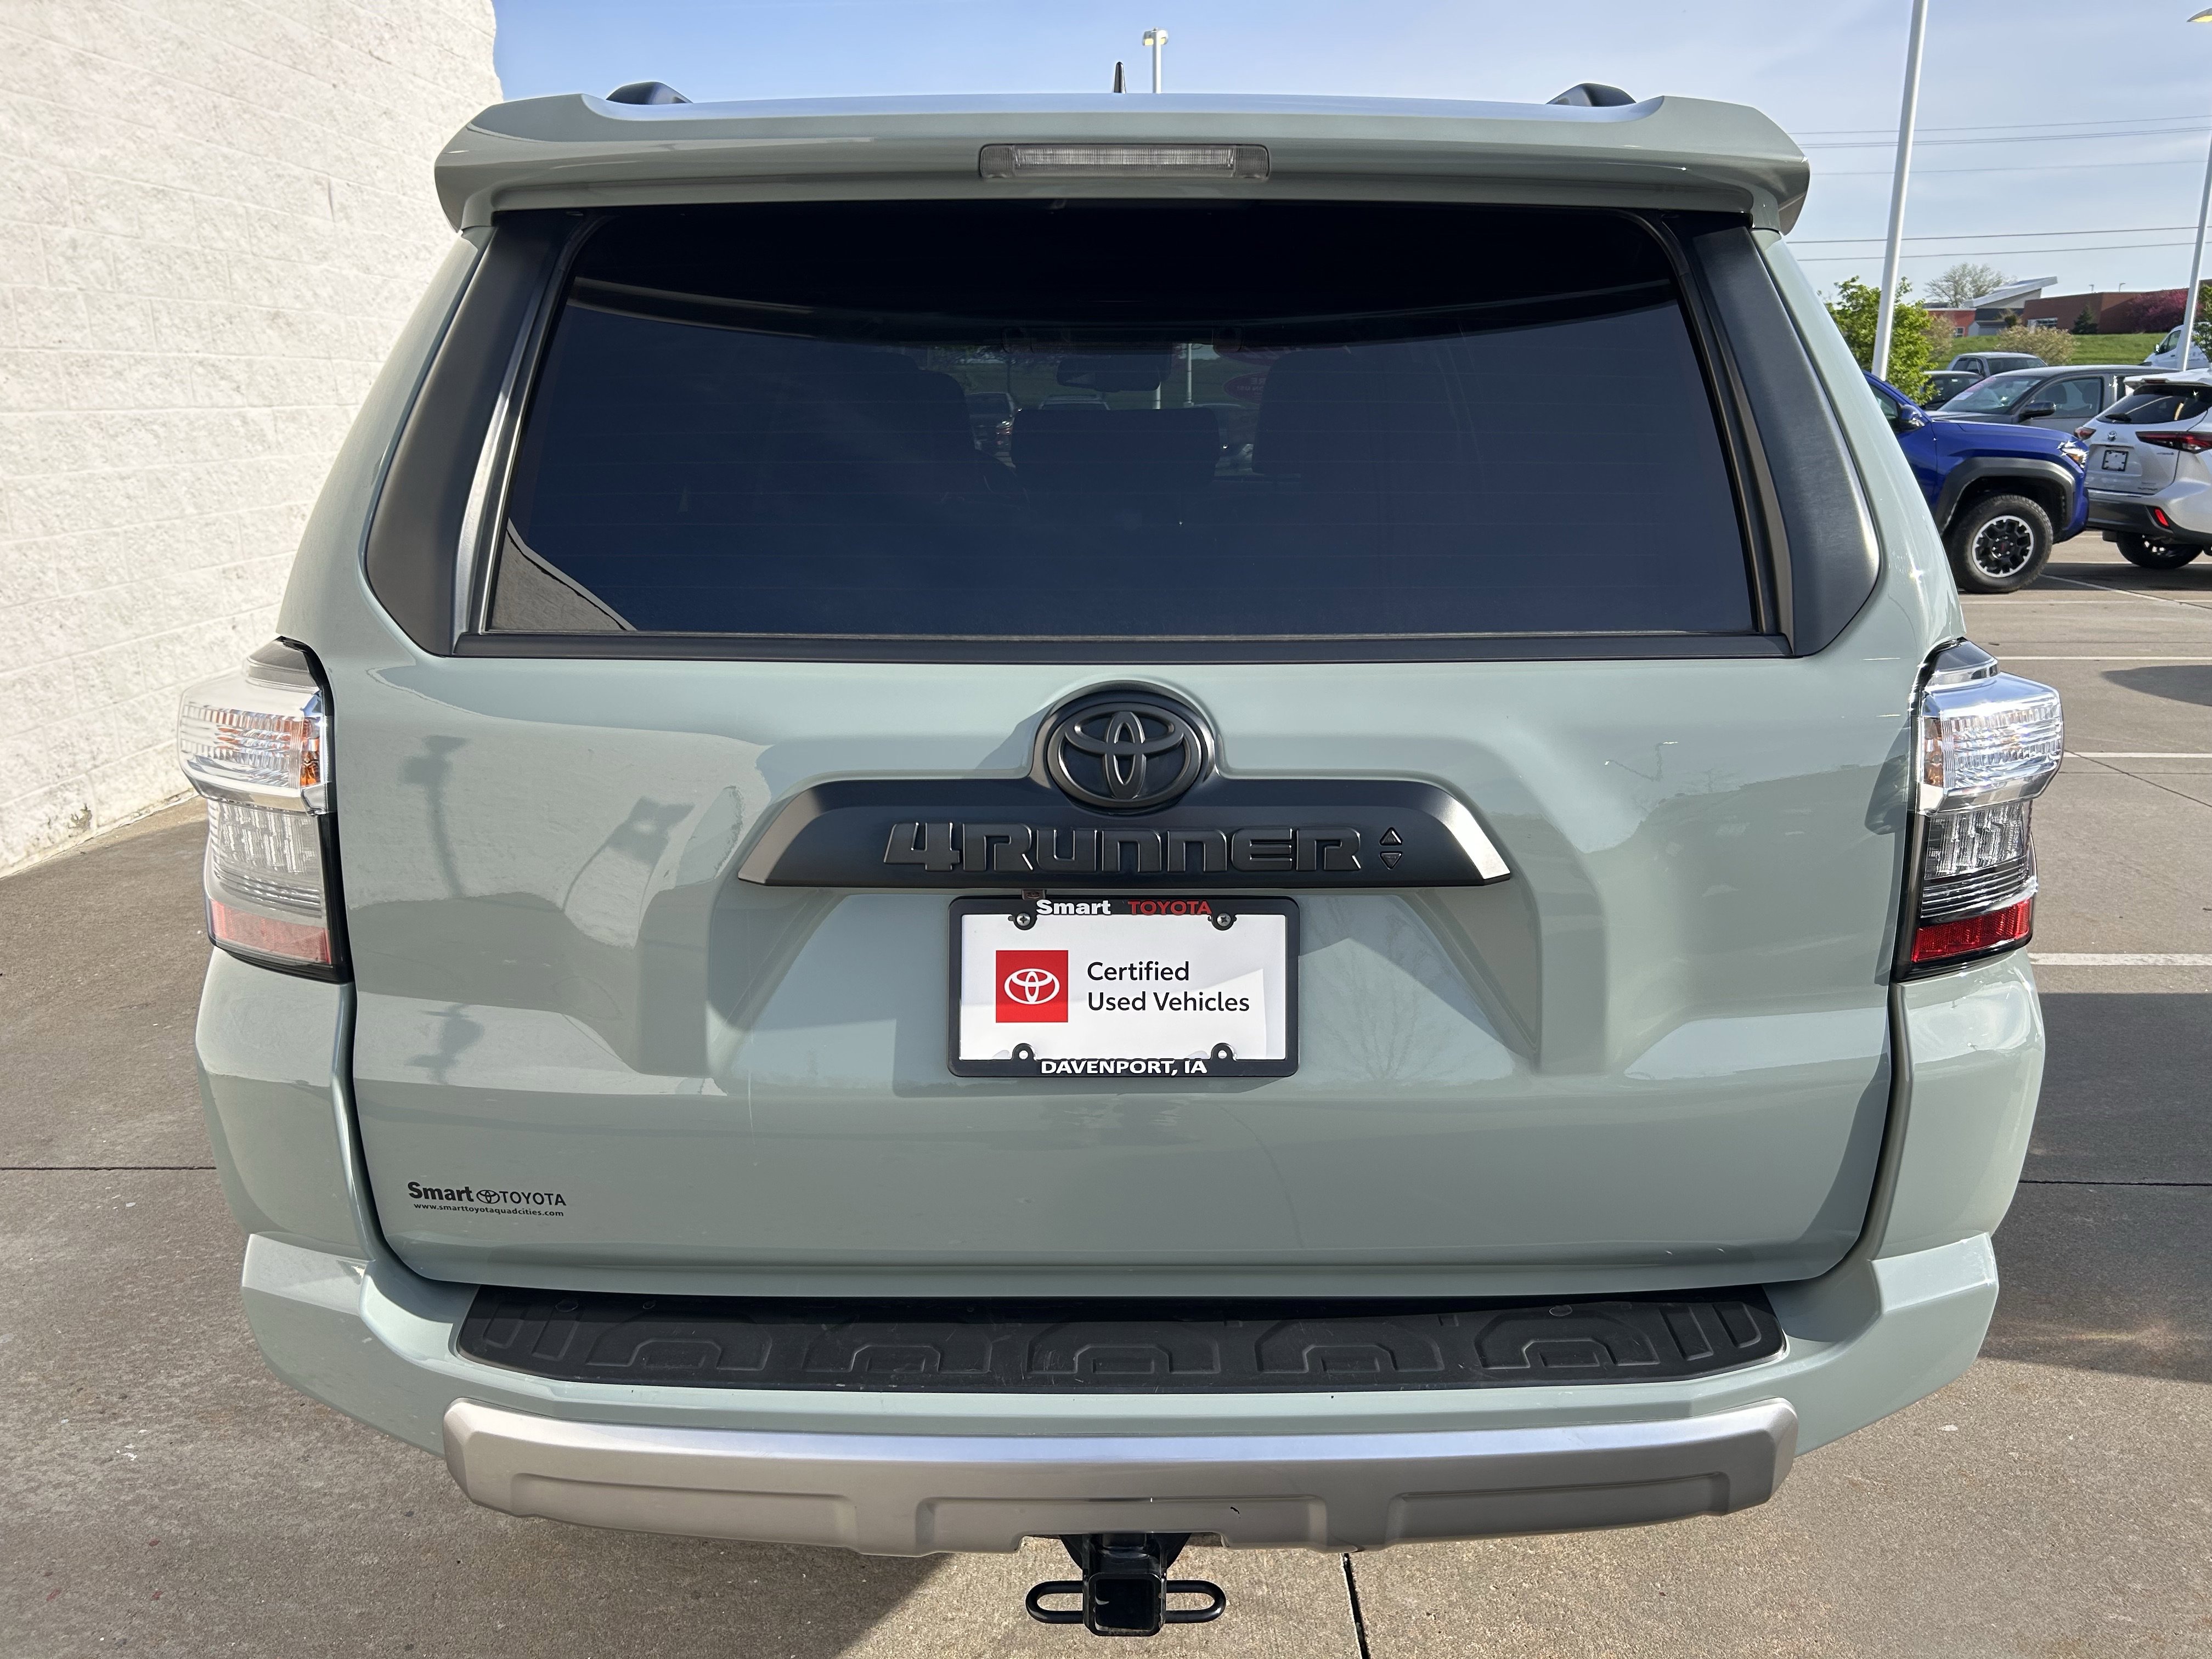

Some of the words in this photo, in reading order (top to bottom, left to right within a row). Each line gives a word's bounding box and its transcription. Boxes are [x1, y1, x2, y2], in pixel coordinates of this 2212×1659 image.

[1036, 900, 1111, 915] Smart
[1127, 900, 1212, 915] TOYOTA
[1087, 961, 1189, 981] Certified
[1087, 991, 1146, 1011] Used
[1153, 991, 1250, 1012] Vehicles
[1041, 1059, 1178, 1076] DAVENPORT,
[1184, 1059, 1207, 1074] IA
[408, 1182, 474, 1202] Smart
[499, 1191, 567, 1206] TOYOTA
[414, 1204, 564, 1216] www.smarttoyotaquadcities.com
